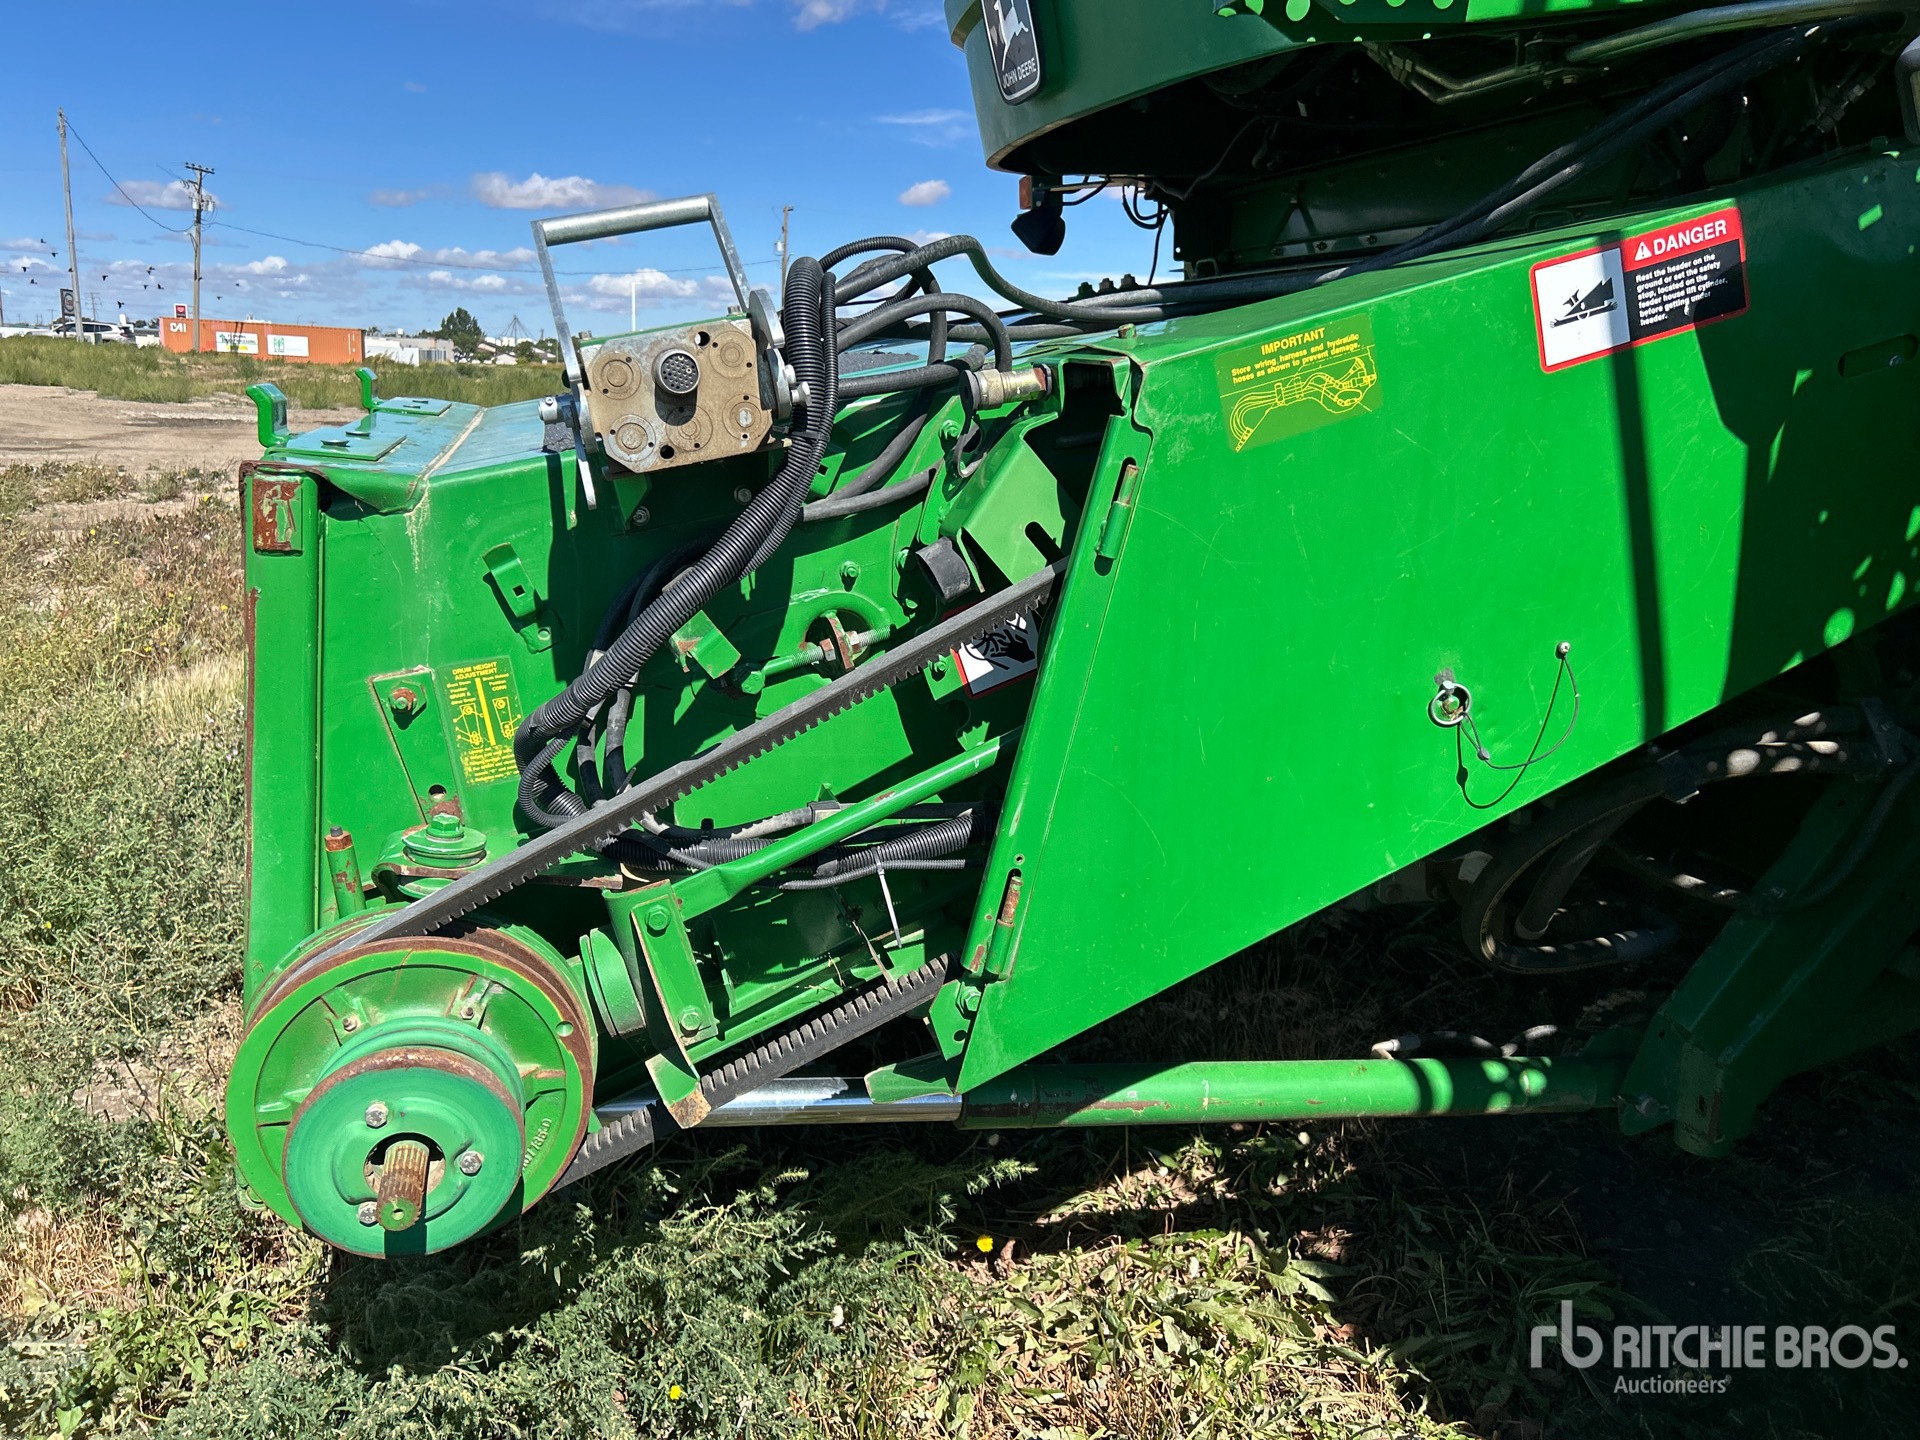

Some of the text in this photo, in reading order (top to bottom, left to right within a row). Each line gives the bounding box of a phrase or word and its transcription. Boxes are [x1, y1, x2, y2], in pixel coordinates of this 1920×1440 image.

[1002, 57, 1036, 88] JOHN DEERE
[1653, 220, 1727, 255] DANGER
[1635, 253, 1716, 283] Rest the header on the
[1636, 261, 1721, 293] ground or set the safety
[1638, 277, 1729, 309] feeder house lift cylinder.
[1657, 281, 1685, 295] located
[1685, 278, 1696, 287] on
[1695, 273, 1708, 283] the
[1639, 291, 1712, 318] before getting under
[1640, 313, 1669, 327] header.
[1231, 333, 1360, 377] Store wiring harness and hydraulic
[1261, 327, 1326, 356] IMPORTANT
[1232, 373, 1255, 384] hoses
[1267, 363, 1291, 375] shown
[1292, 359, 1301, 367] to
[1302, 351, 1329, 365] prevent
[1331, 341, 1361, 356] damage.
[456, 668, 497, 680] ADJUSTMENT
[473, 661, 497, 671] HEIGHT
